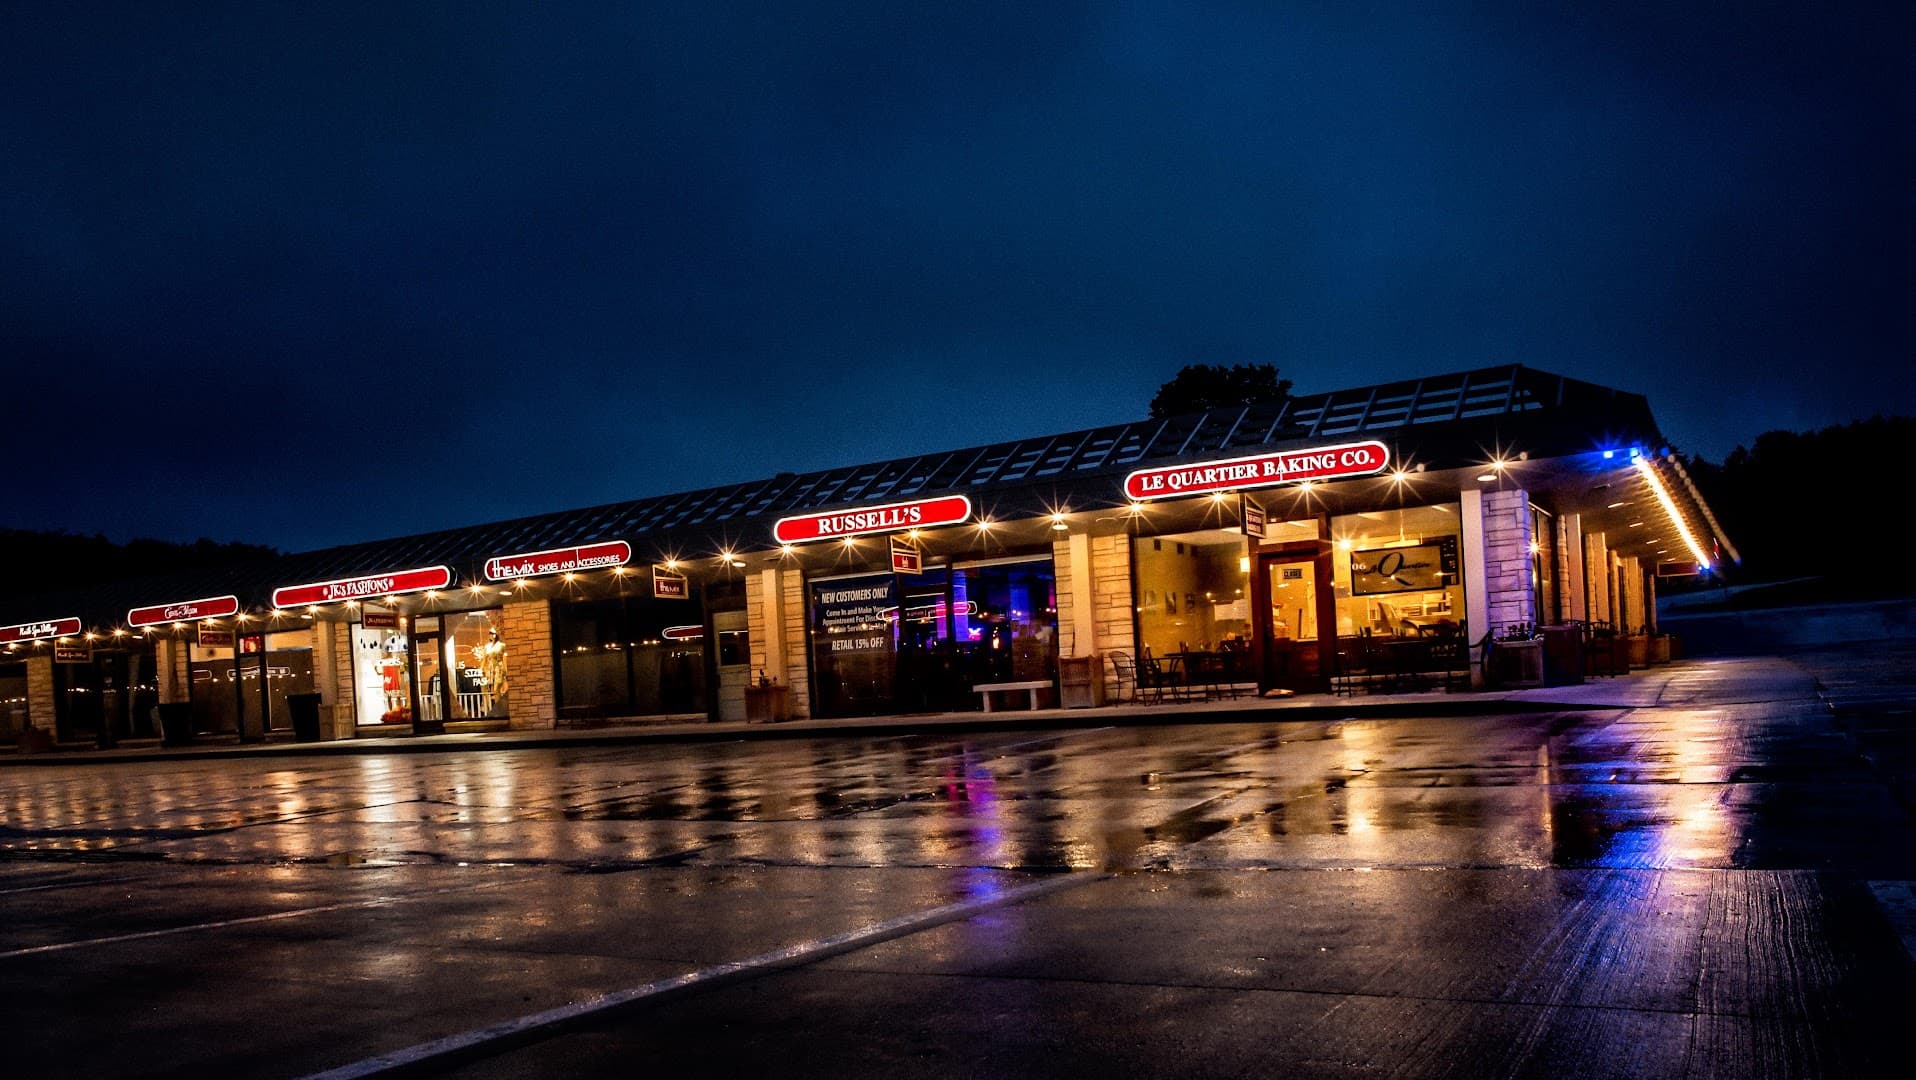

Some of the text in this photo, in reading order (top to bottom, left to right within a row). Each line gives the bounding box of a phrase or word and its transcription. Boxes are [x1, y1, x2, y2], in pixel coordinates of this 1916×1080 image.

[1141, 449, 1376, 491] LE QUARTIER BAKING CO.
[817, 506, 922, 534] RUSSELL'S
[538, 562, 558, 573] SHOES
[560, 561, 576, 570] AND
[578, 555, 620, 568] ACCESSORIES
[347, 578, 390, 595] FASHIONS
[821, 587, 889, 604] NEW CUSTOMERS ONLY
[832, 637, 884, 651] RETAIL 15% OFF
